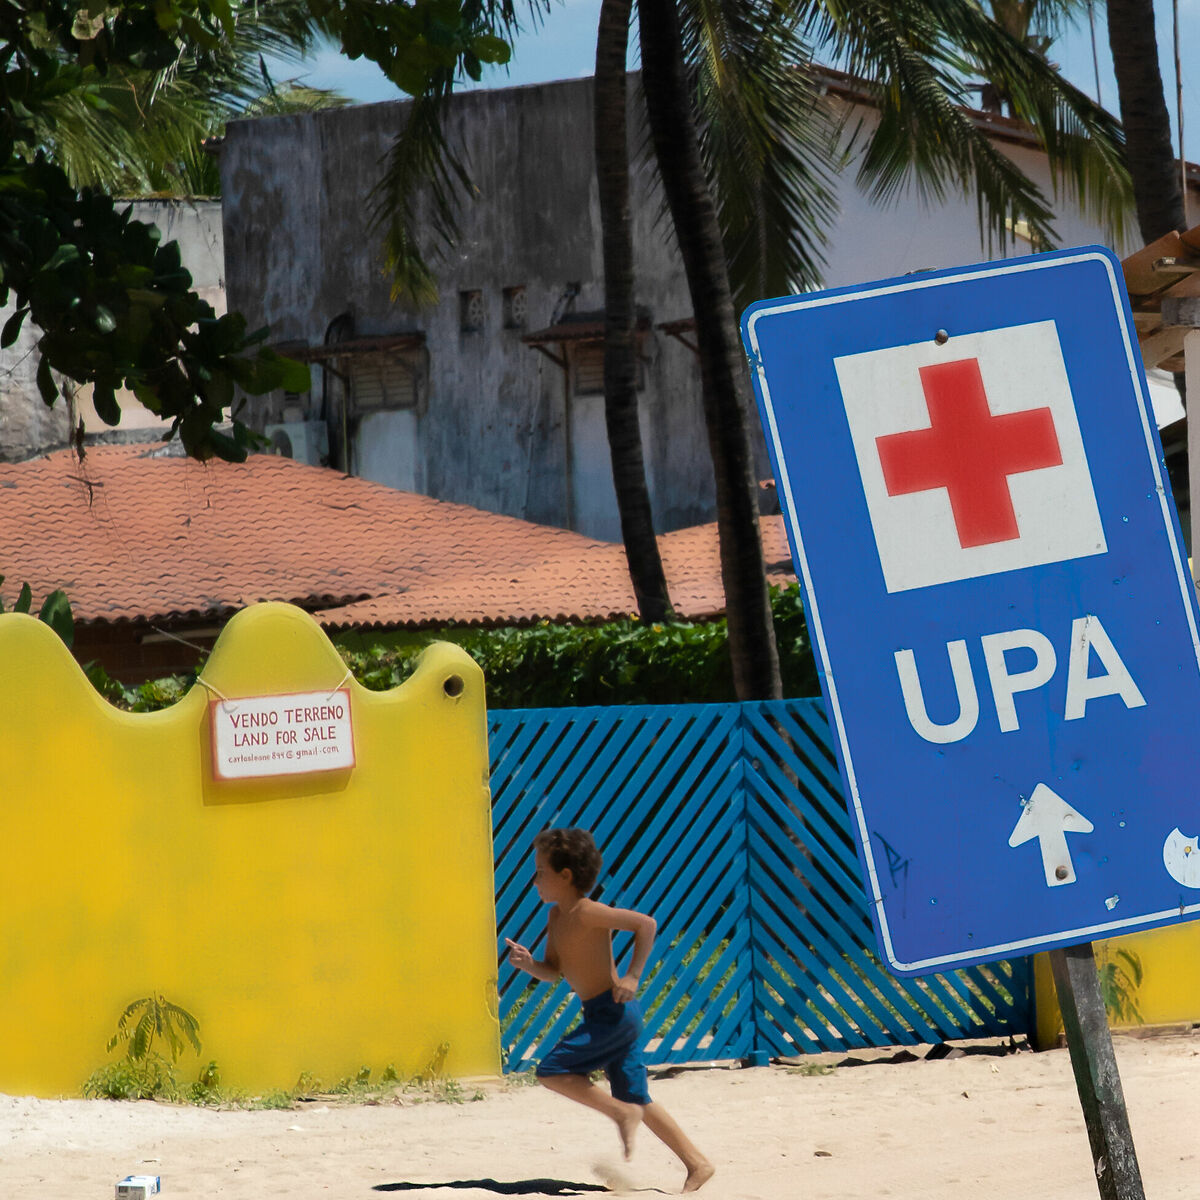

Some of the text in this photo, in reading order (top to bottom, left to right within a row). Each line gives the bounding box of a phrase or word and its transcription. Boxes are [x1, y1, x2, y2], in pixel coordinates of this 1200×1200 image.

[894, 615, 1147, 744] UPA
[230, 705, 344, 728] VENDO TERRENO
[234, 726, 336, 747] LAND FOR SALE
